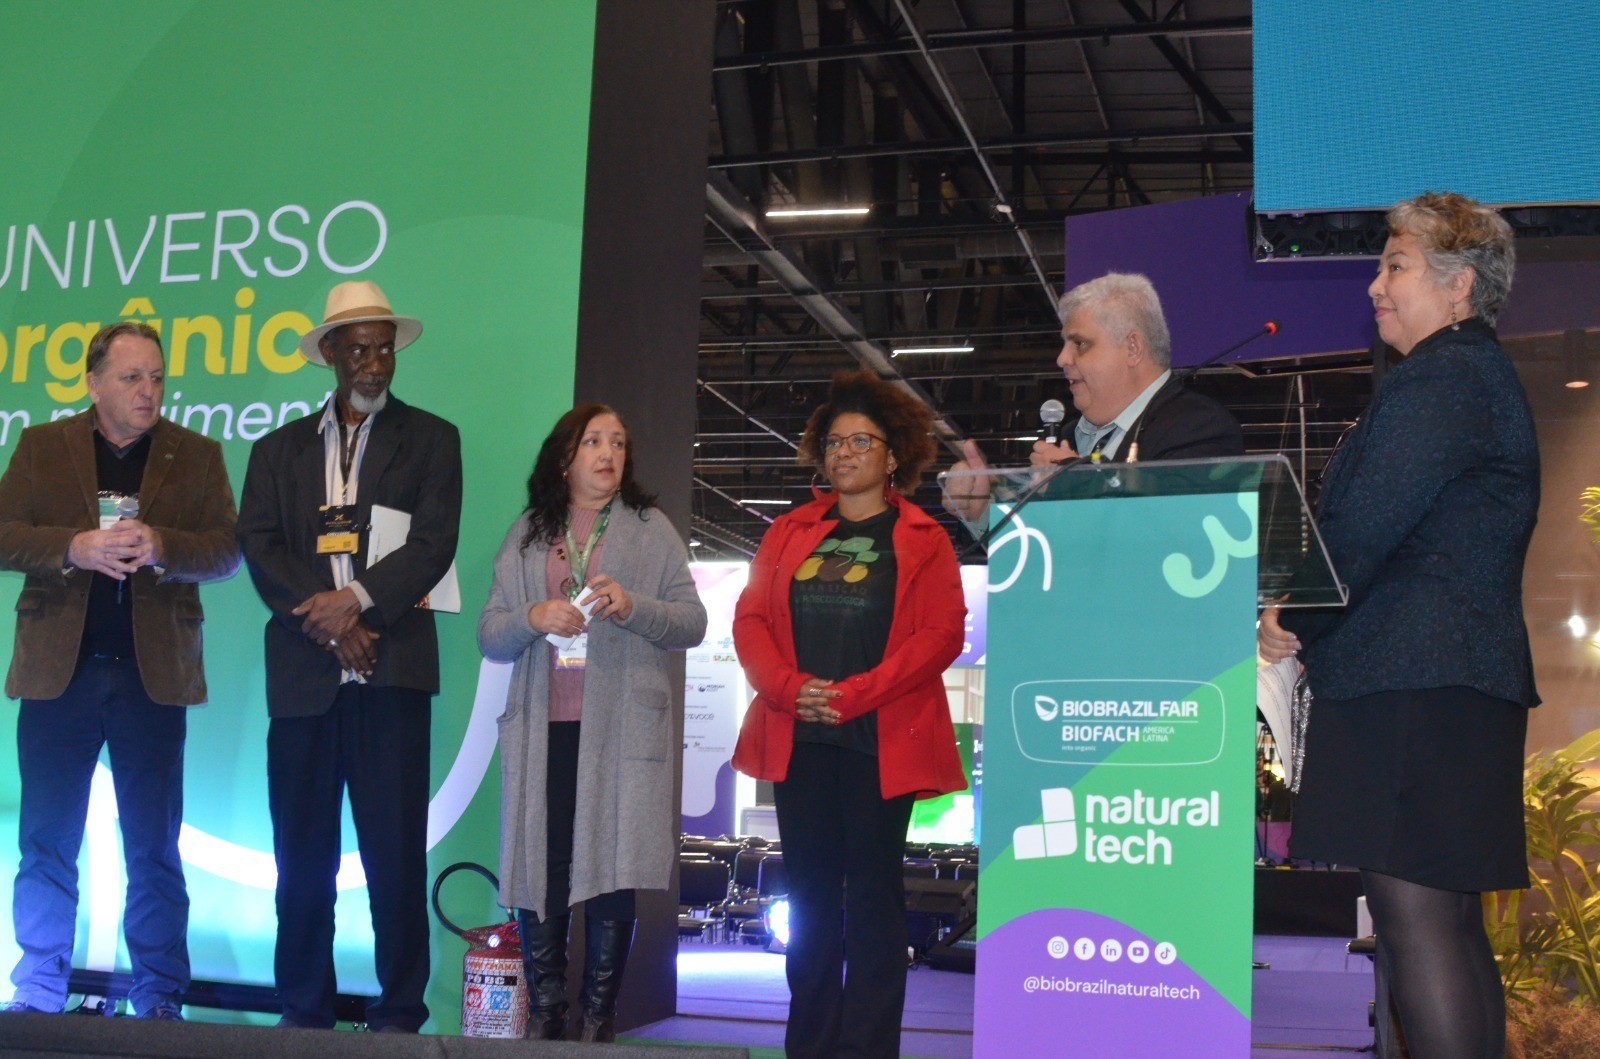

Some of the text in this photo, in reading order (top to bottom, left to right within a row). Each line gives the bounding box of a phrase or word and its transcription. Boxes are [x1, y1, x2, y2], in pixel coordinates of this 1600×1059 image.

[0, 287, 315, 404] rgnic
[1062, 700, 1198, 718] BIOBRAZIL FAIR
[1062, 725, 1140, 742] BIOFACH
[1143, 726, 1175, 735] AMERICA
[1143, 734, 1169, 743] LATINA
[1085, 788, 1219, 827] natural
[1085, 827, 1172, 865] tech
[1023, 975, 1200, 1000] @biobrazilnaturaltech
